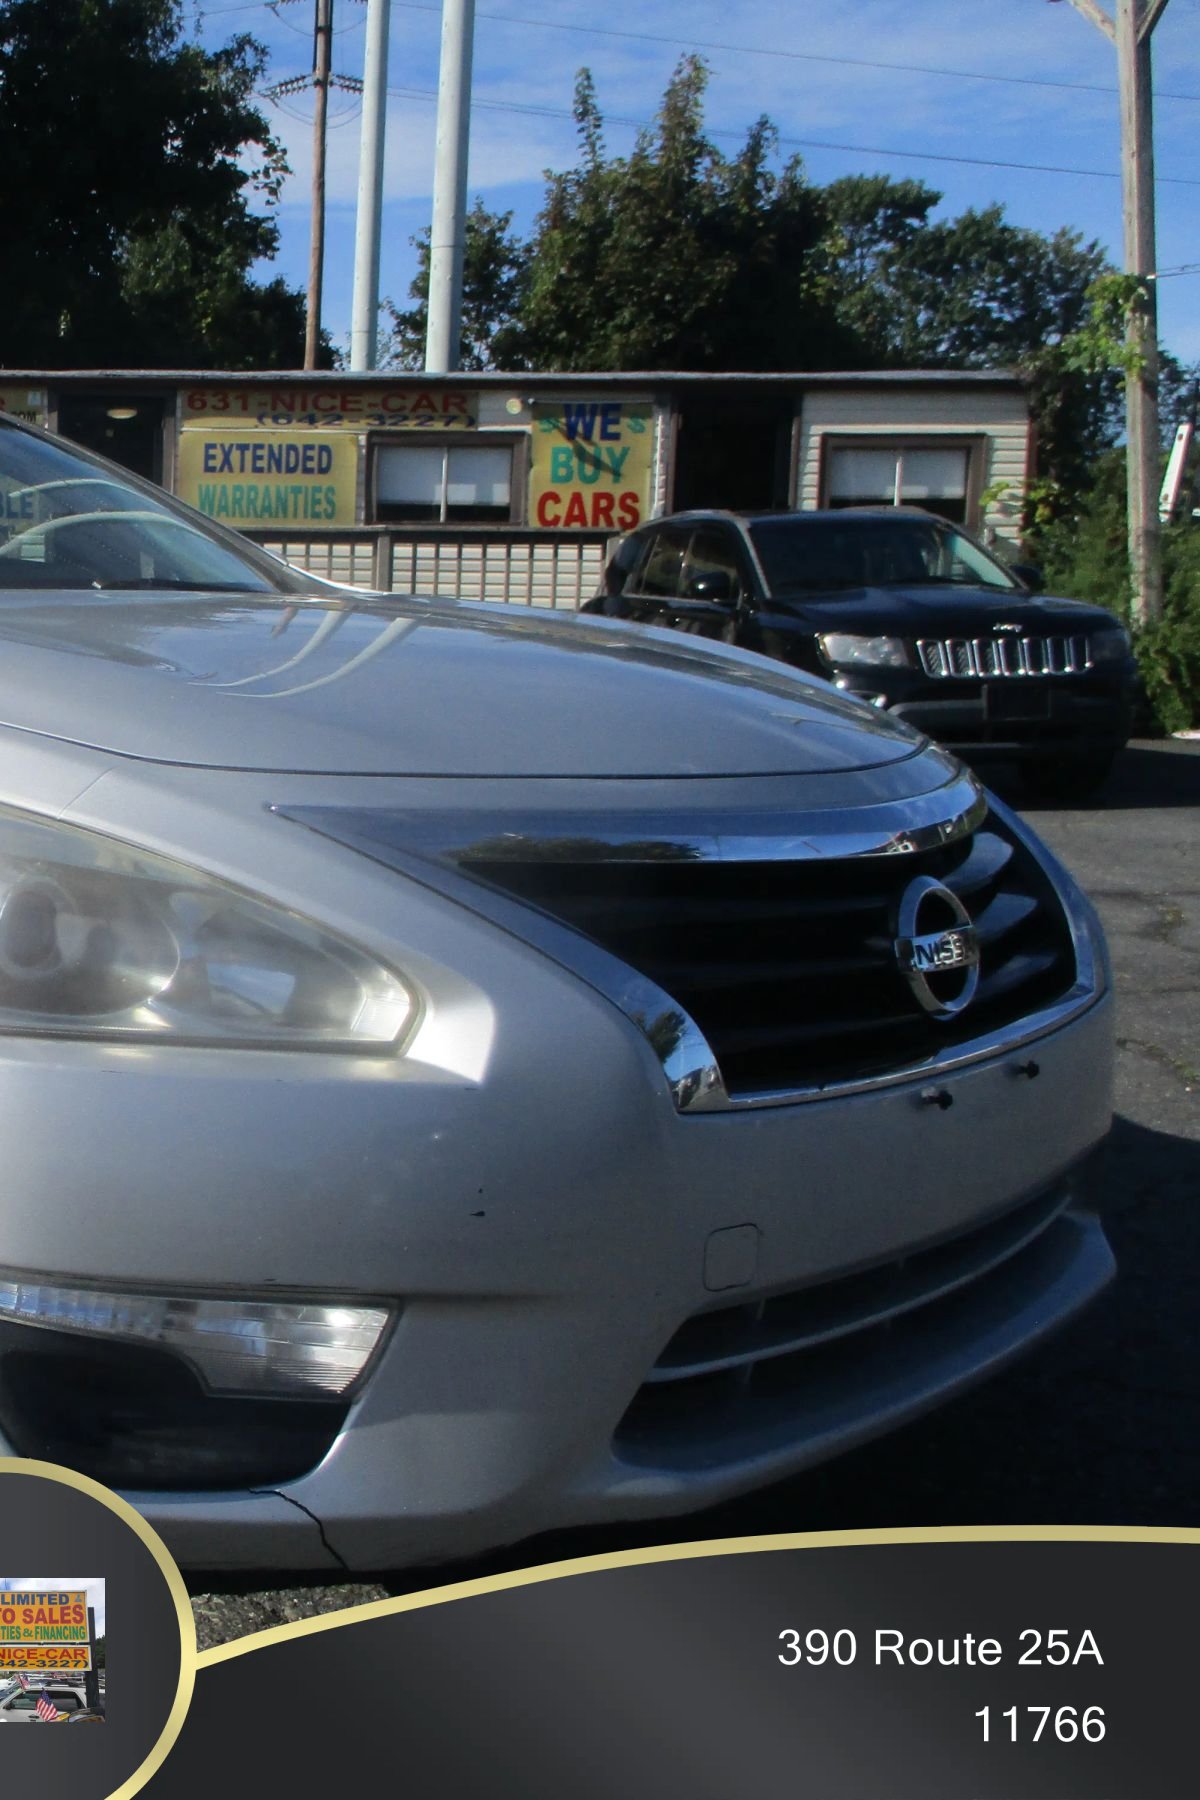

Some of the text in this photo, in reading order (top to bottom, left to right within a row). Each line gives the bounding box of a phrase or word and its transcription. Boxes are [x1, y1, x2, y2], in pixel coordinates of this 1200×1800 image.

[187, 391, 469, 413] 631-NICE-CAR
[256, 412, 476, 428] (642-3227)
[564, 403, 622, 441] WE
[203, 443, 333, 475] EXTENDED
[551, 446, 631, 484] BUY
[198, 483, 337, 520] WARRANTIES
[537, 491, 640, 531] CARS
